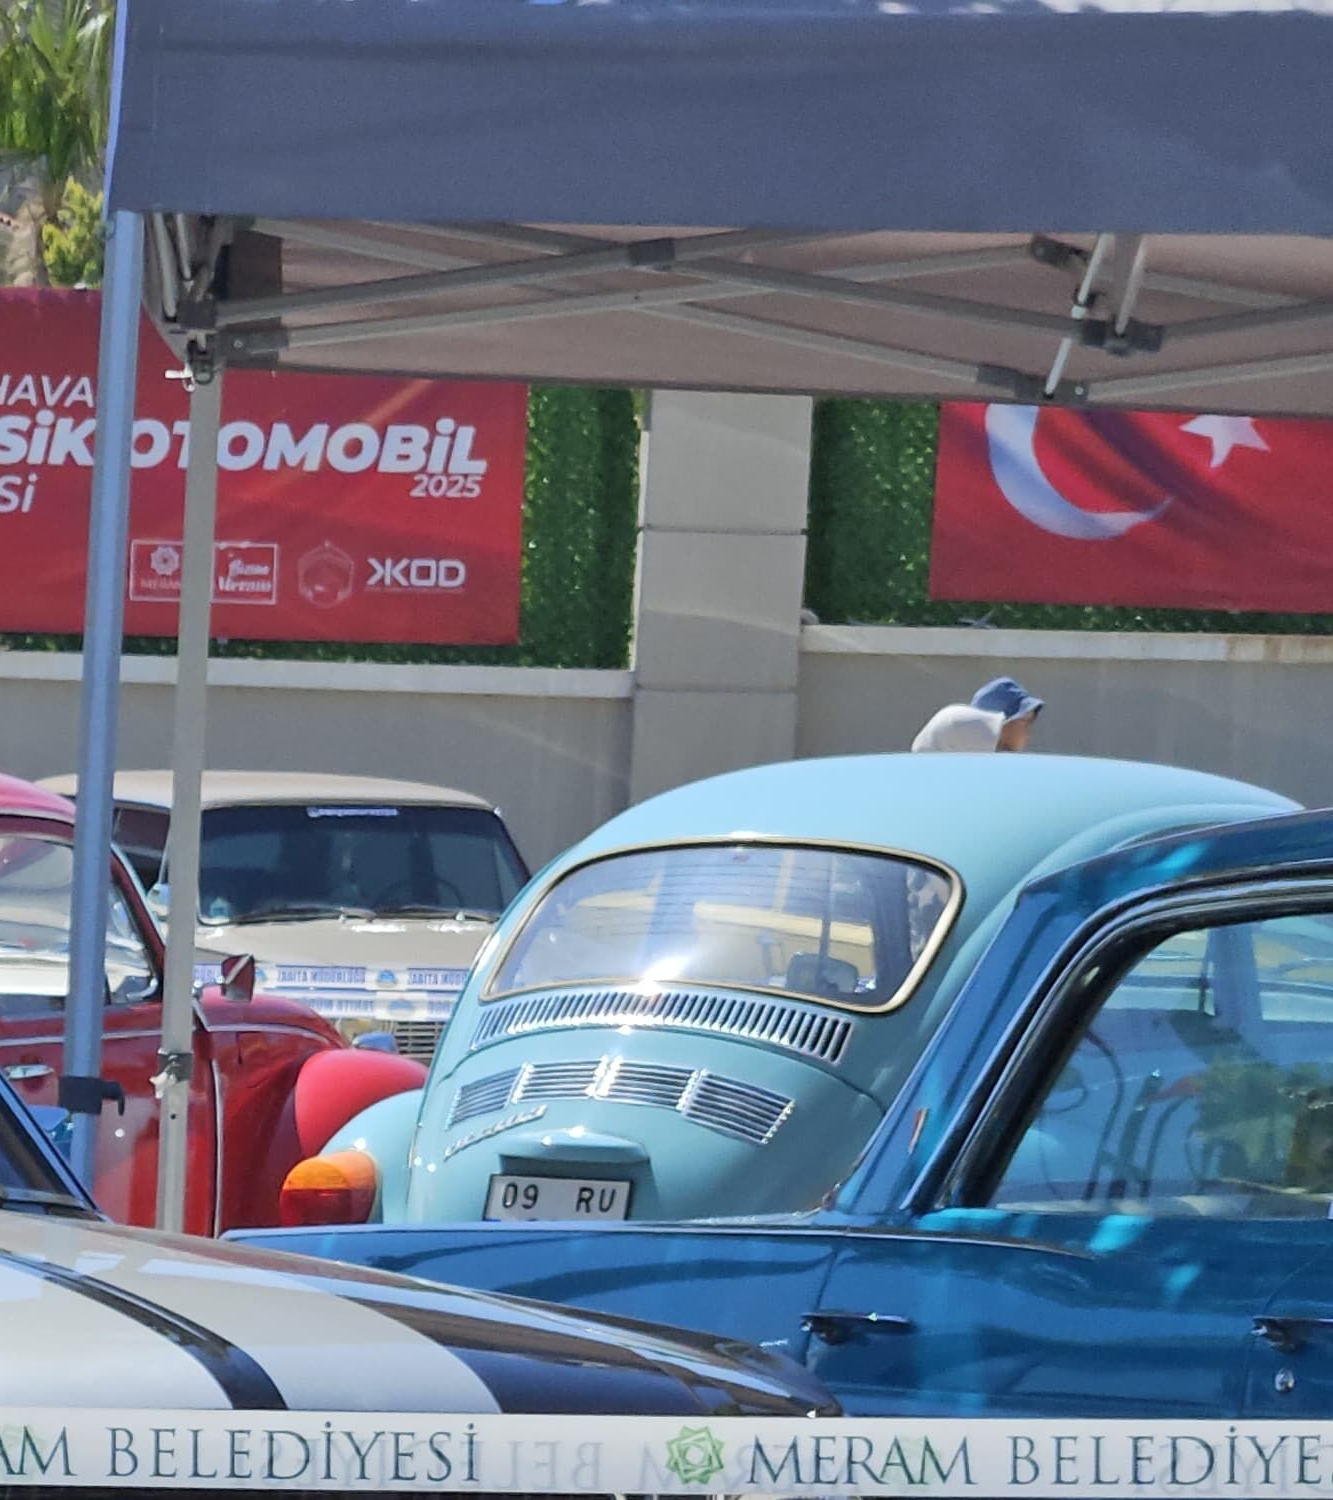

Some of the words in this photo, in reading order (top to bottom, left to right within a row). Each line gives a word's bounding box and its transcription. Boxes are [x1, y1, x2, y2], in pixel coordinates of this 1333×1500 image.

[410, 474, 483, 498] 2025
[501, 1182, 539, 1209] 09
[575, 1187, 616, 1213] RU
[106, 1421, 479, 1483] BELEDİYESİ
[747, 1434, 978, 1485] MERAM
[1007, 1426, 1333, 1486] BELEDİYE
